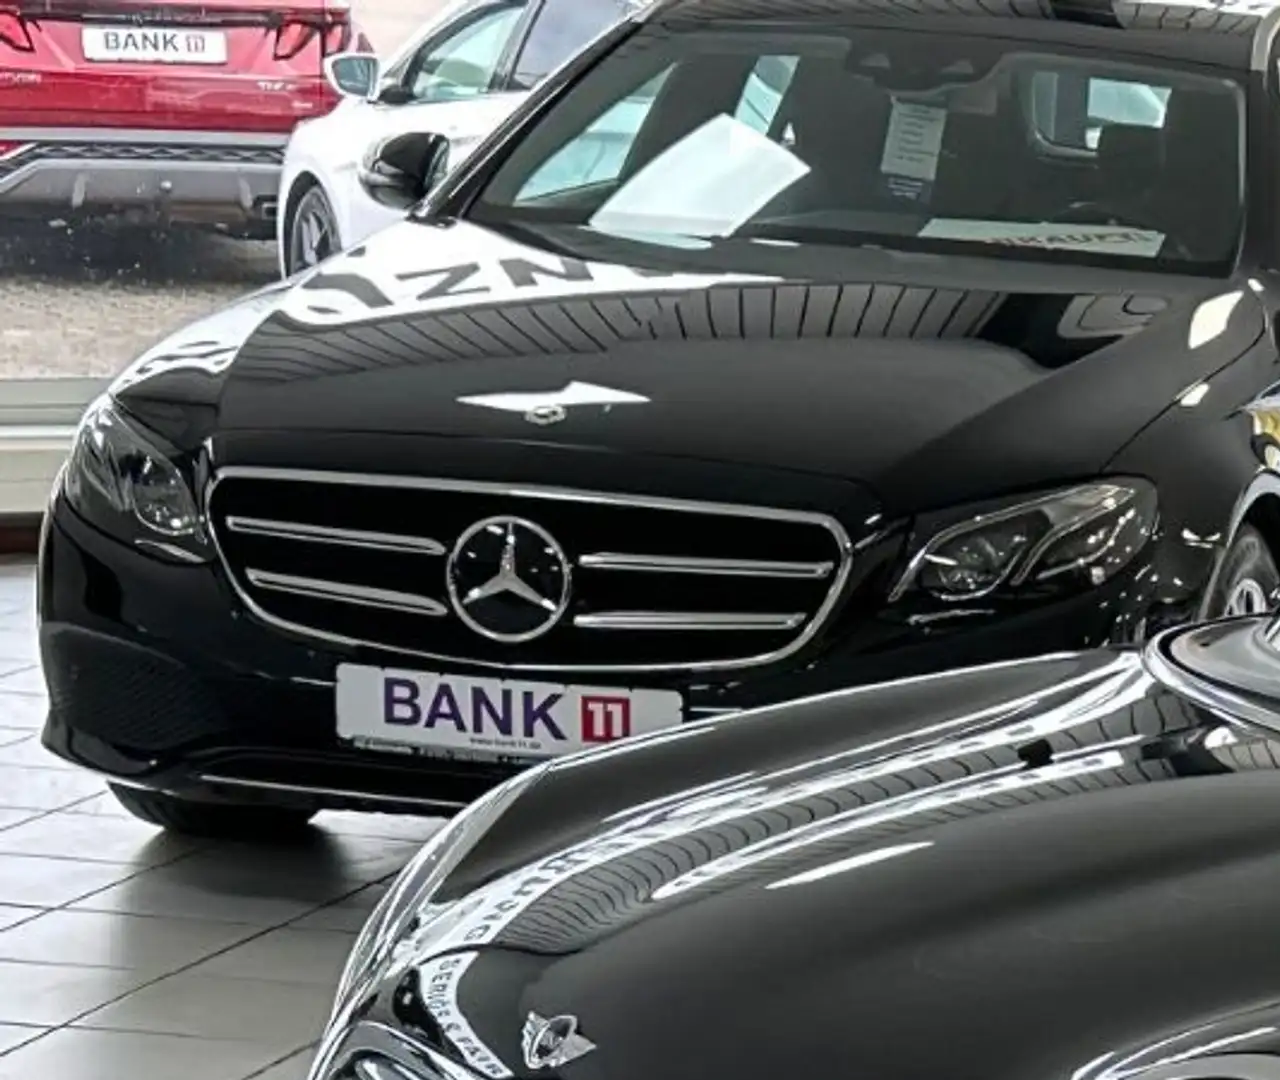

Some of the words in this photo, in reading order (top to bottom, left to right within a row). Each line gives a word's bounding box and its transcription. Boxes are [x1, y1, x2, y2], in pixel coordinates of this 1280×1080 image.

[104, 31, 179, 52] BANK
[383, 676, 568, 741] BANK
[583, 698, 628, 741] 11
